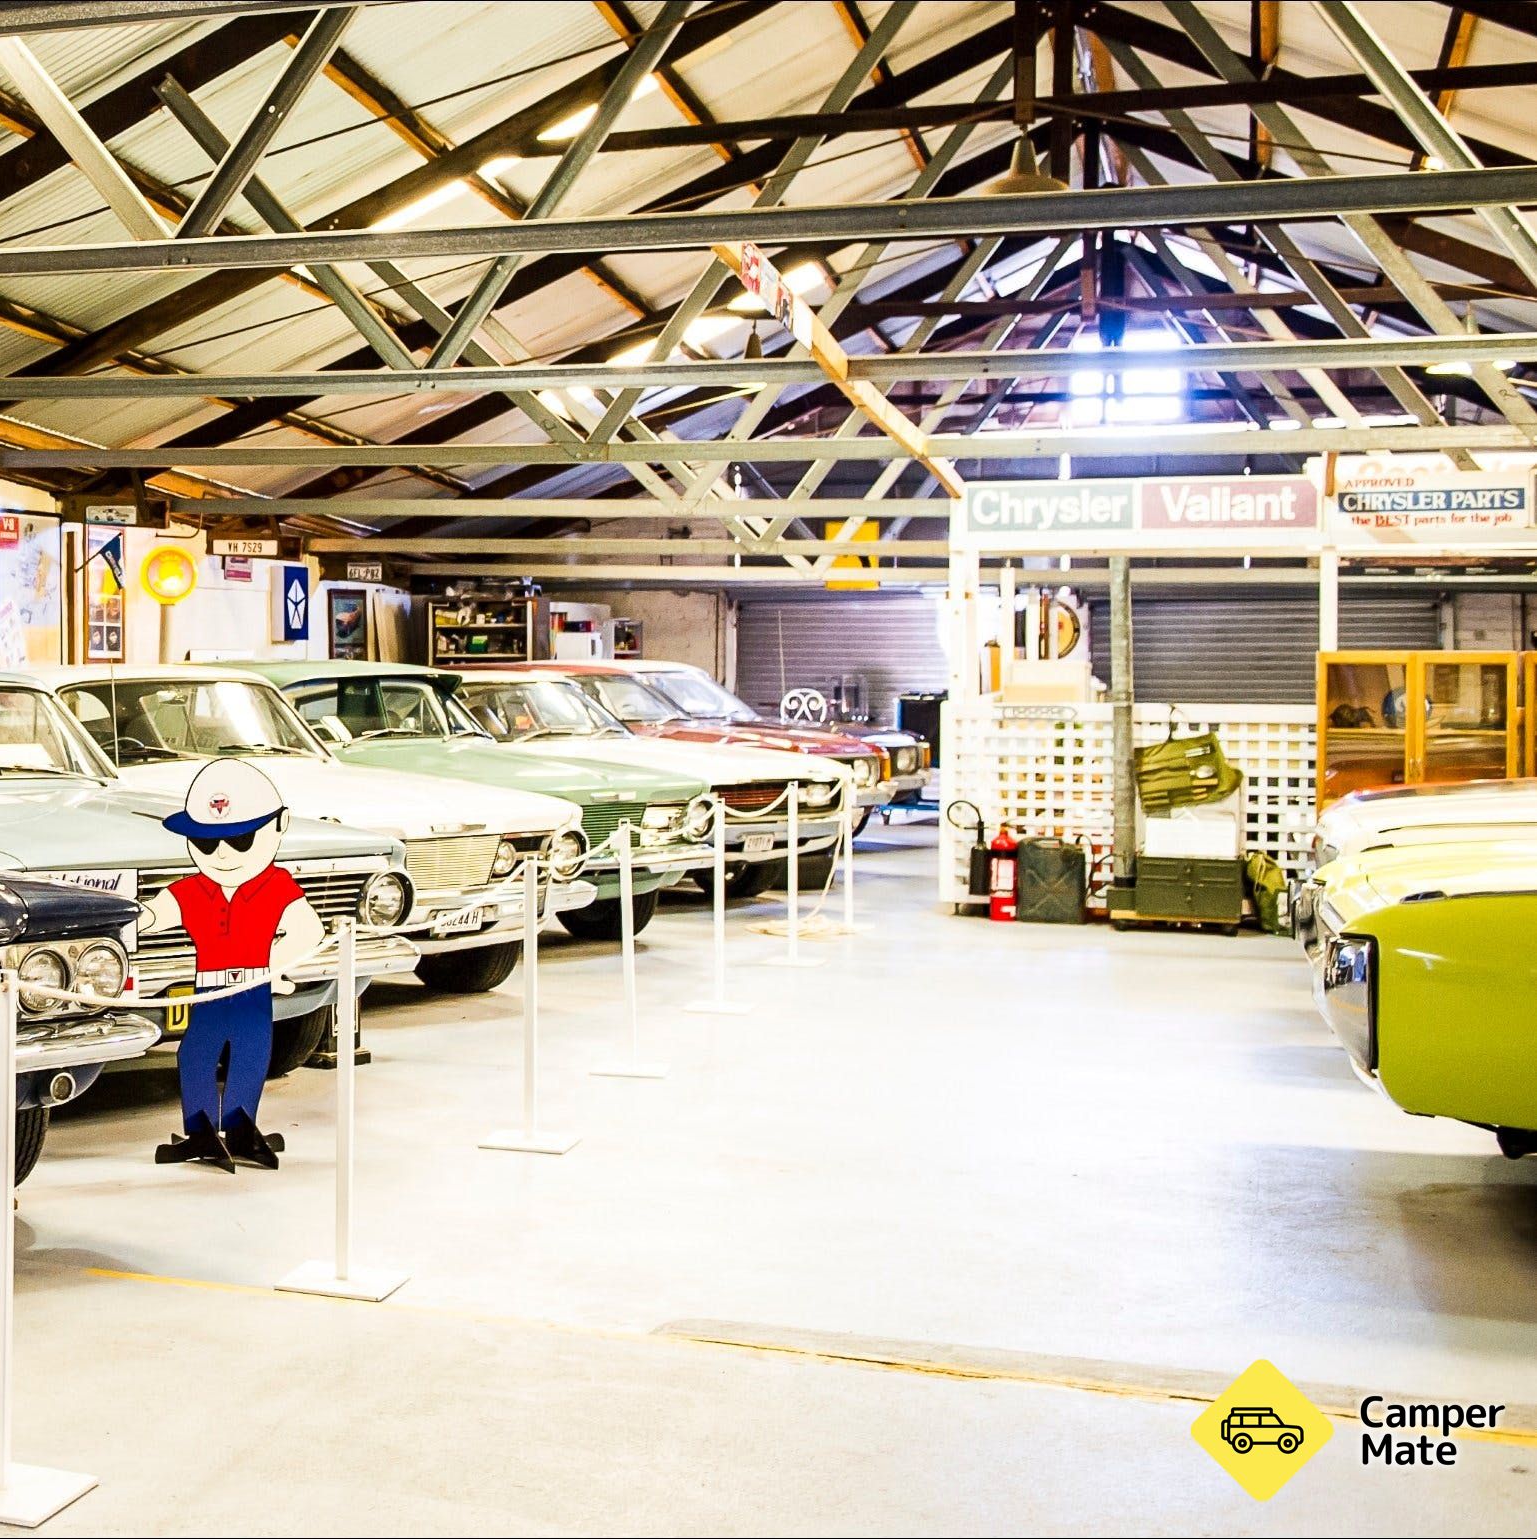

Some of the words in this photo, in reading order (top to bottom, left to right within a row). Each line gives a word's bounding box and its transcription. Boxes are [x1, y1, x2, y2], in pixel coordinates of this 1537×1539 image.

[1344, 477, 1415, 489] APPROVED
[972, 488, 1127, 530] Chrysler
[1159, 484, 1297, 523] Valiant
[1342, 491, 1447, 513] CHRYSLER
[1450, 489, 1521, 510] PARTS
[1351, 515, 1371, 526] the
[1374, 513, 1410, 528] BEST
[1414, 515, 1446, 527] parts
[1450, 513, 1467, 524] for
[1470, 512, 1490, 524] the
[1494, 512, 1512, 527] job
